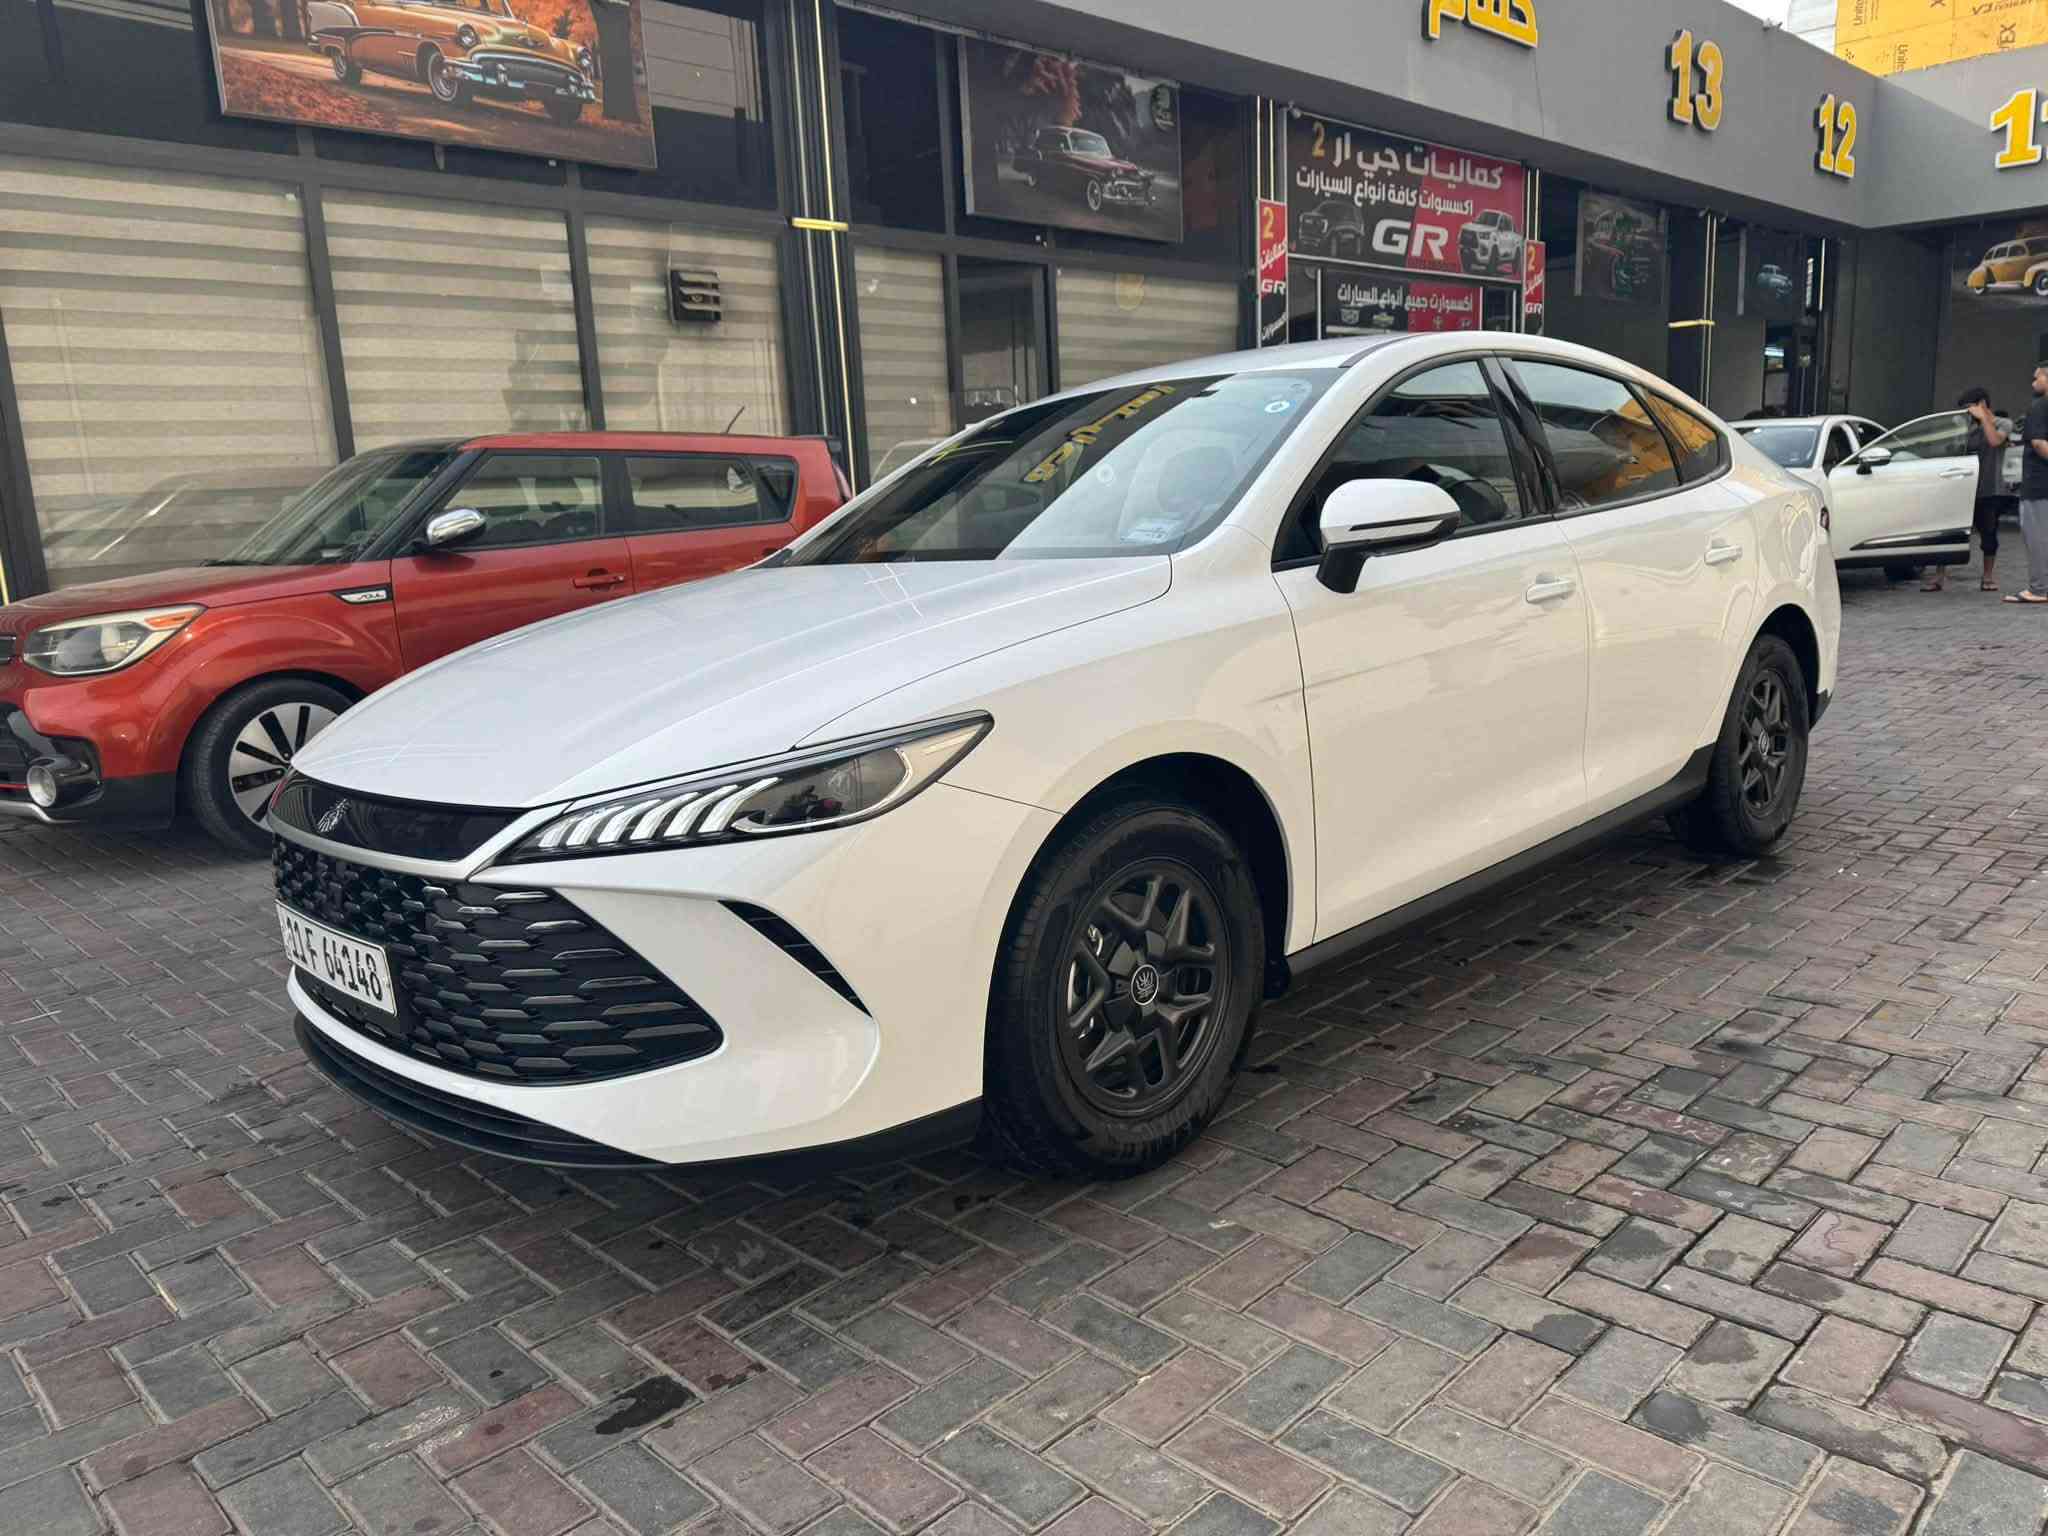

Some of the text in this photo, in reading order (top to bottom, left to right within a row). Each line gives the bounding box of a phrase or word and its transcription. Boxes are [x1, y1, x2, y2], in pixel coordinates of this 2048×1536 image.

[1670, 29, 1724, 131] 13
[1311, 120, 1326, 158] 2
[1818, 93, 1857, 178] 12
[1989, 87, 2048, 170] 1
[1357, 146, 1400, 178] جي
[1405, 144, 1504, 189] كماليات
[1296, 165, 1352, 198] السيارات
[1354, 179, 1386, 207] انواع
[1387, 183, 1418, 208] كافة
[1263, 206, 1275, 240] 2
[1371, 217, 1449, 261] GR
[1527, 246, 1537, 273] 2
[1261, 278, 1287, 295] GR
[1336, 282, 1378, 308] السيارات
[1525, 302, 1543, 315] GR
[304, 927, 319, 970] F
[322, 936, 384, 1002] 64148
